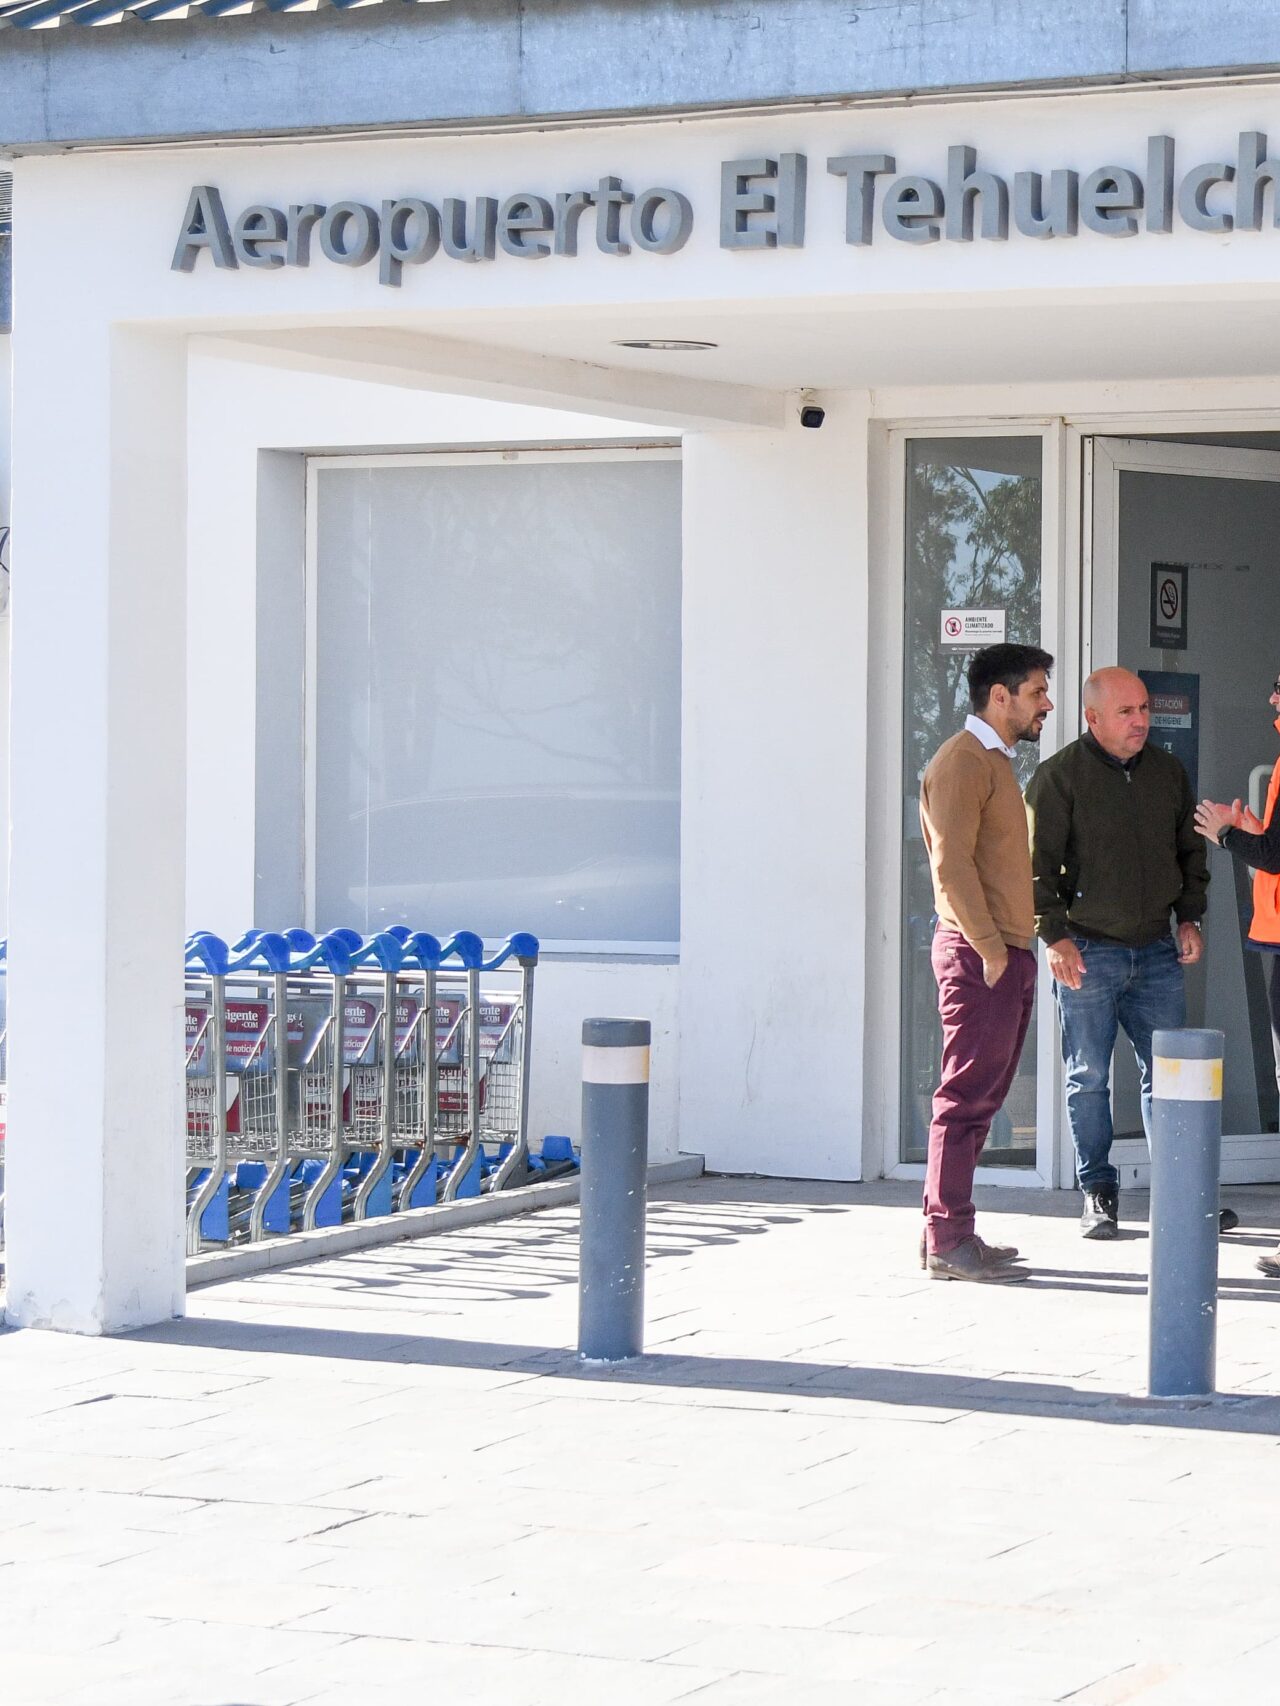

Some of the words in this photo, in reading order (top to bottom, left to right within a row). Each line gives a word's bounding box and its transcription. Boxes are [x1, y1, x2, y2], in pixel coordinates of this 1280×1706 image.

[171, 176, 693, 288] Aeropuerto
[719, 153, 807, 251] El
[1154, 698, 1183, 710] ESTACIÓN
